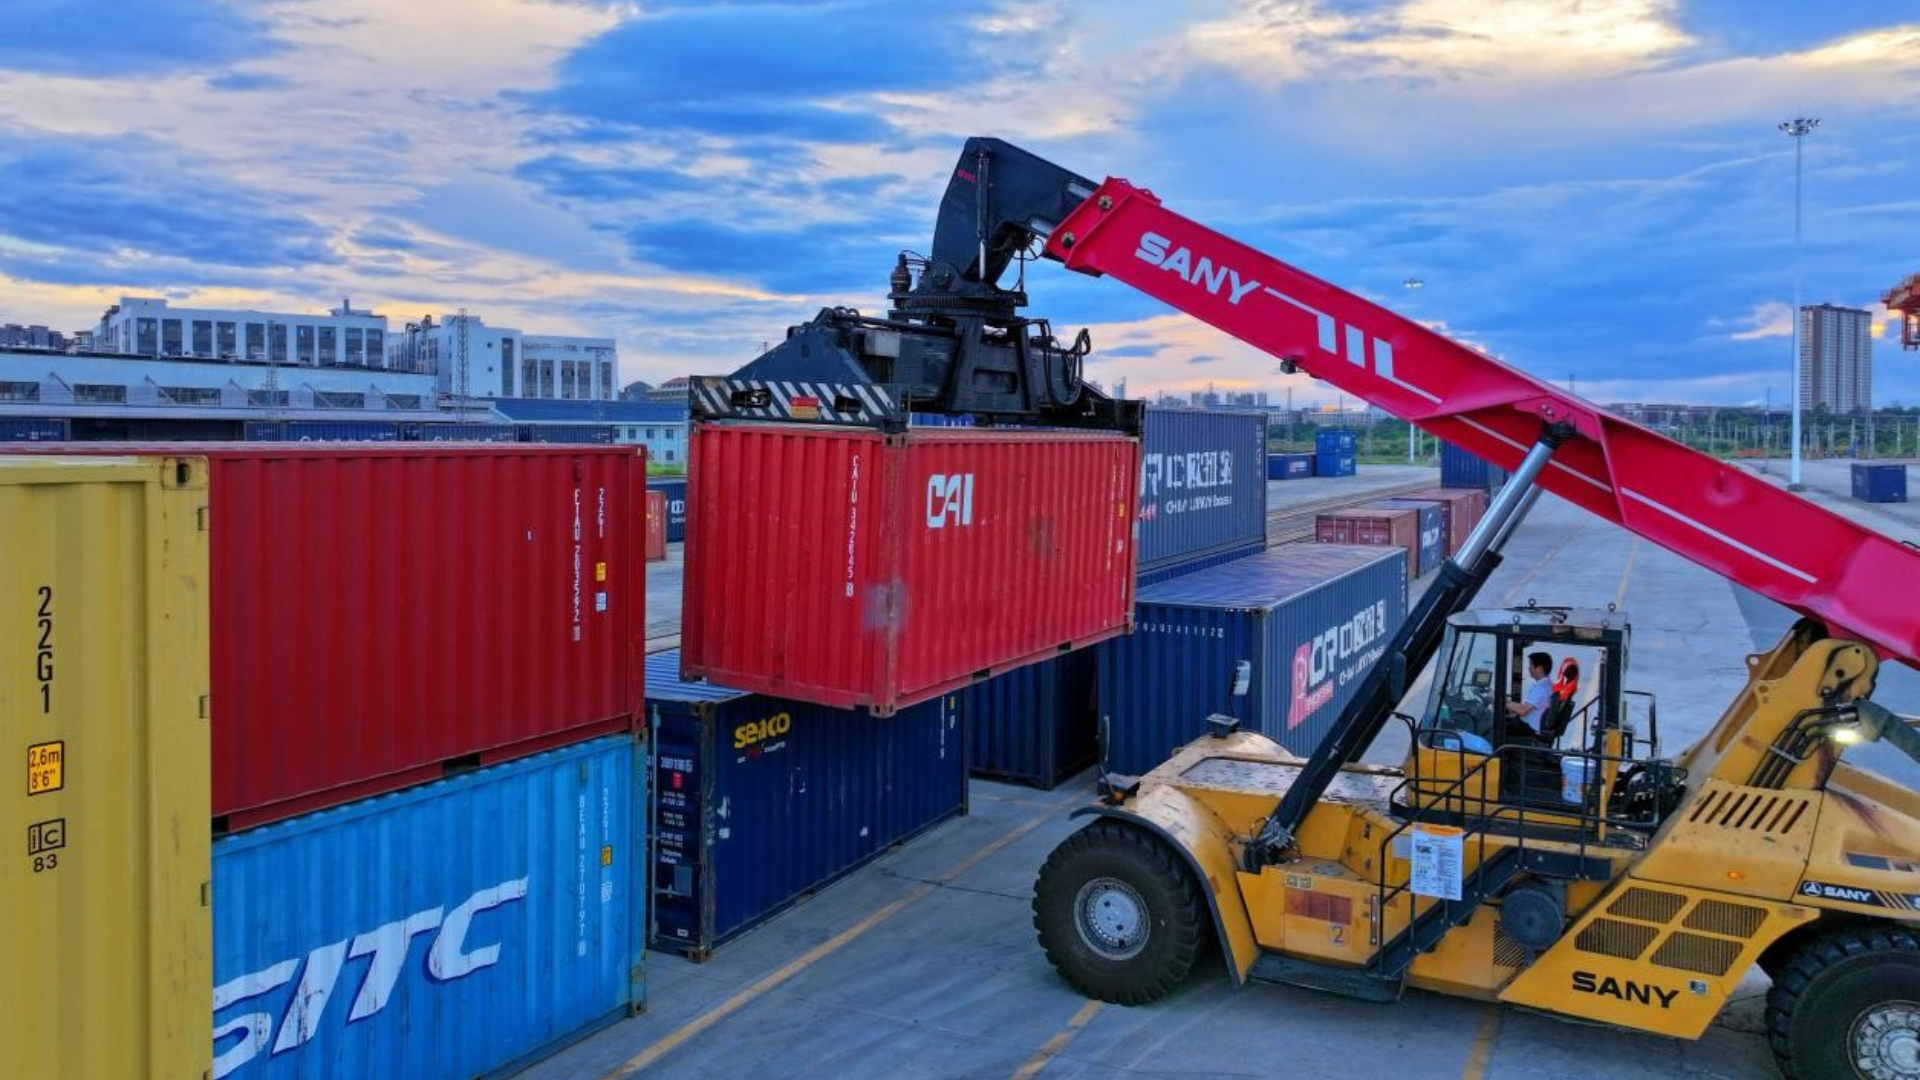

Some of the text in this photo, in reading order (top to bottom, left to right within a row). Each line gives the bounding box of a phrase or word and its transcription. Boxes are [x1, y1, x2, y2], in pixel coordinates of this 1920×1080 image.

[1134, 231, 1260, 306] SANY
[926, 473, 974, 529] CAI
[38, 586, 53, 714] 22G1
[30, 748, 60, 769] 2,6m
[33, 853, 58, 873] 83
[1824, 885, 1871, 902] SANY
[1332, 925, 1345, 945] 2
[1572, 970, 1680, 1009] SANY
